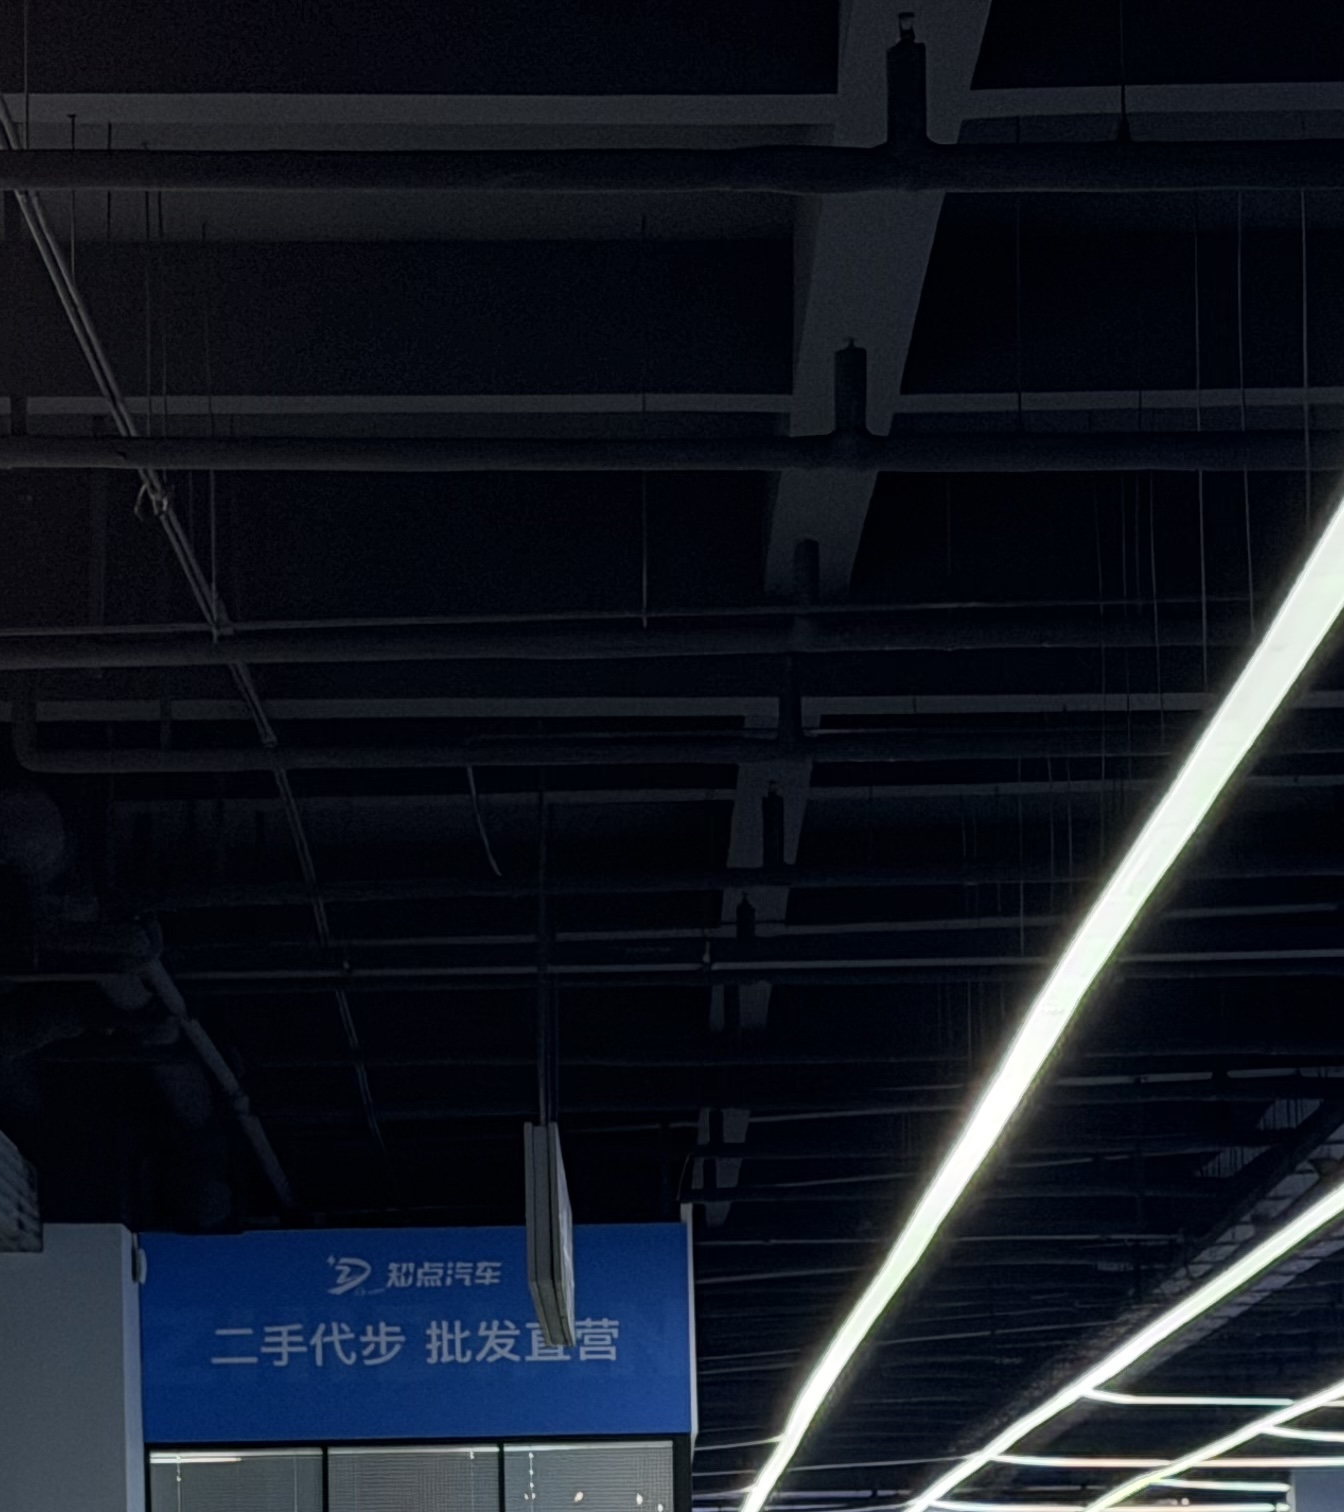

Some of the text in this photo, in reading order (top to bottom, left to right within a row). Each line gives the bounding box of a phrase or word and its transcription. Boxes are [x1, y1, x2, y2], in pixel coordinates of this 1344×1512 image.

[387, 1262, 502, 1288] 知点汽车
[211, 1321, 406, 1367] 二手代步
